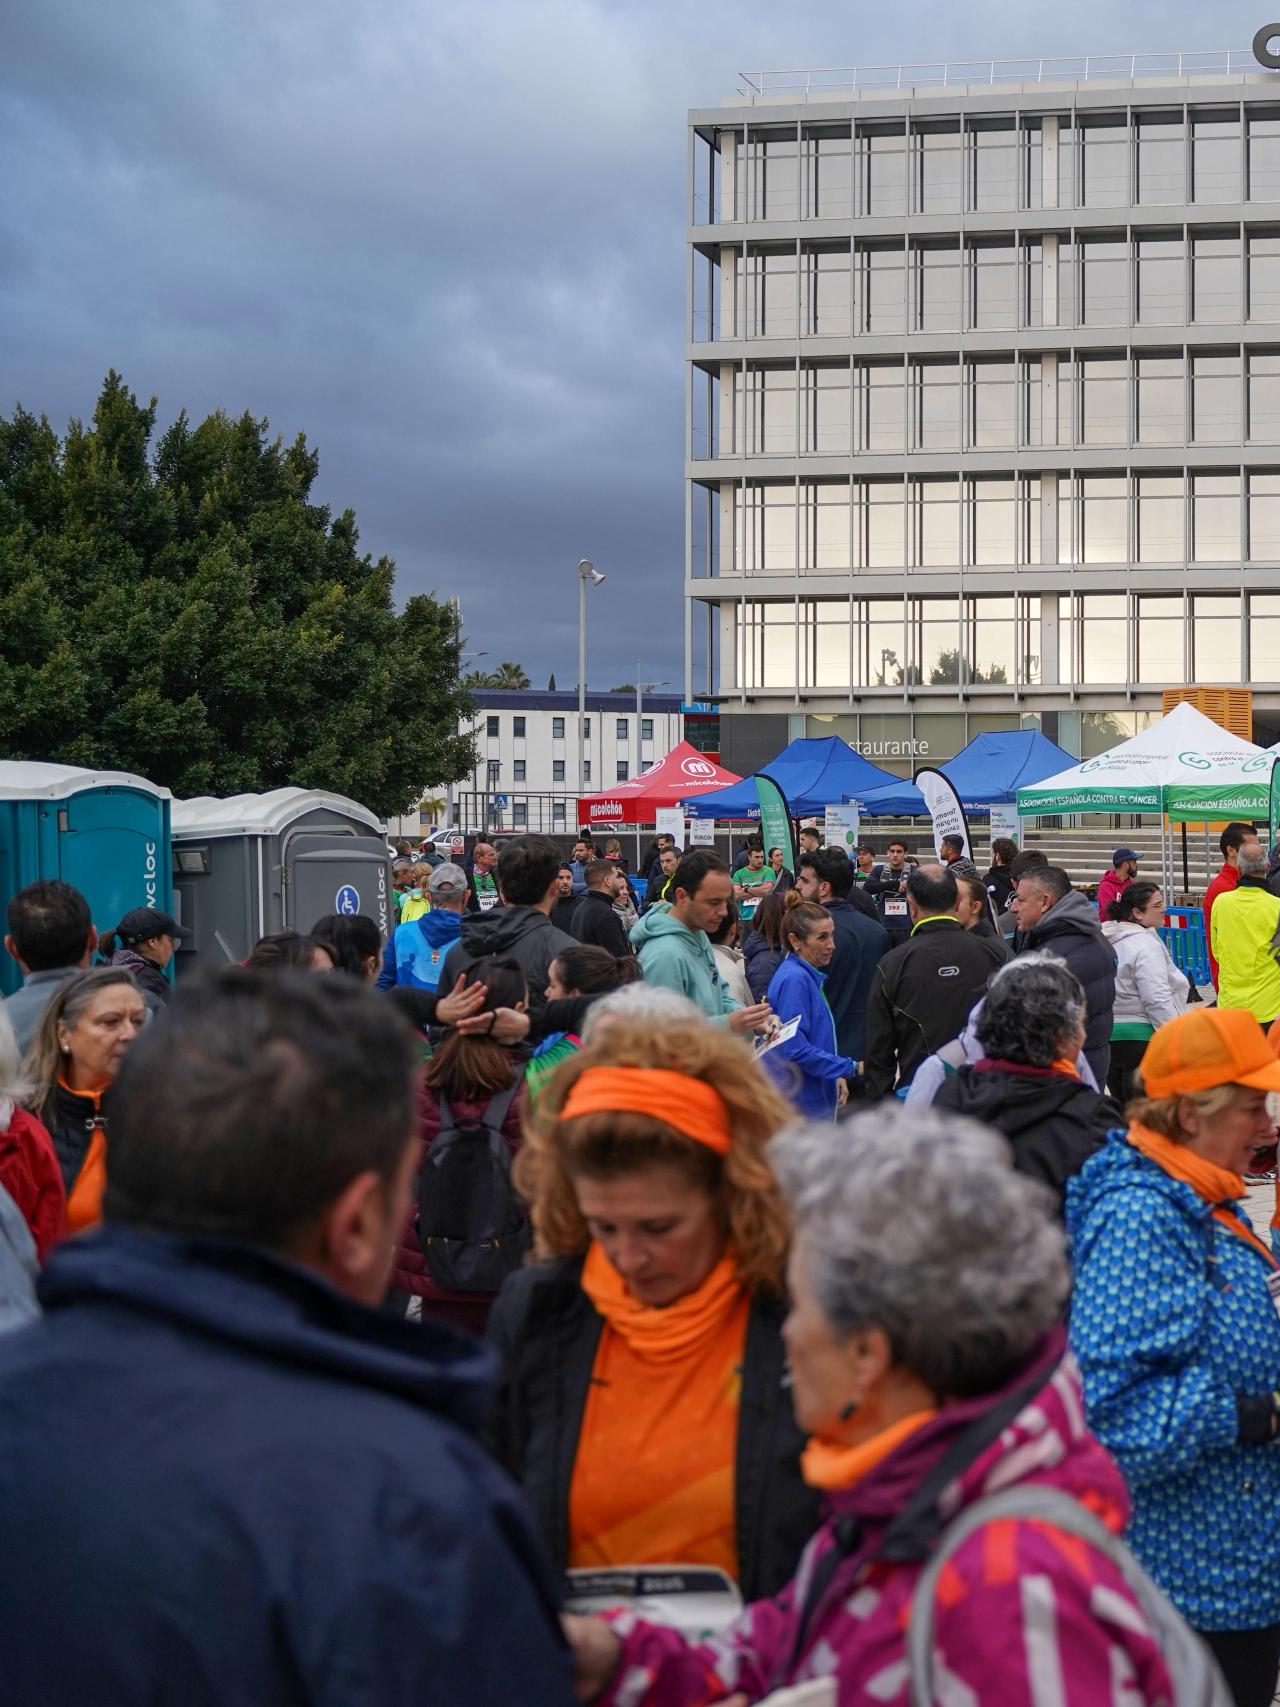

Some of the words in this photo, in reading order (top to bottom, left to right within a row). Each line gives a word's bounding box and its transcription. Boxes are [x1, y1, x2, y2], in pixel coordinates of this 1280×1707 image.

[1058, 793, 1091, 805] ESPAÑOLA
[1092, 794, 1119, 804] CONTRA
[1120, 795, 1129, 804] EL
[1129, 794, 1157, 805] CÁNCER
[1219, 796, 1257, 808] ESPAÑOLA
[590, 800, 623, 817] micolchón
